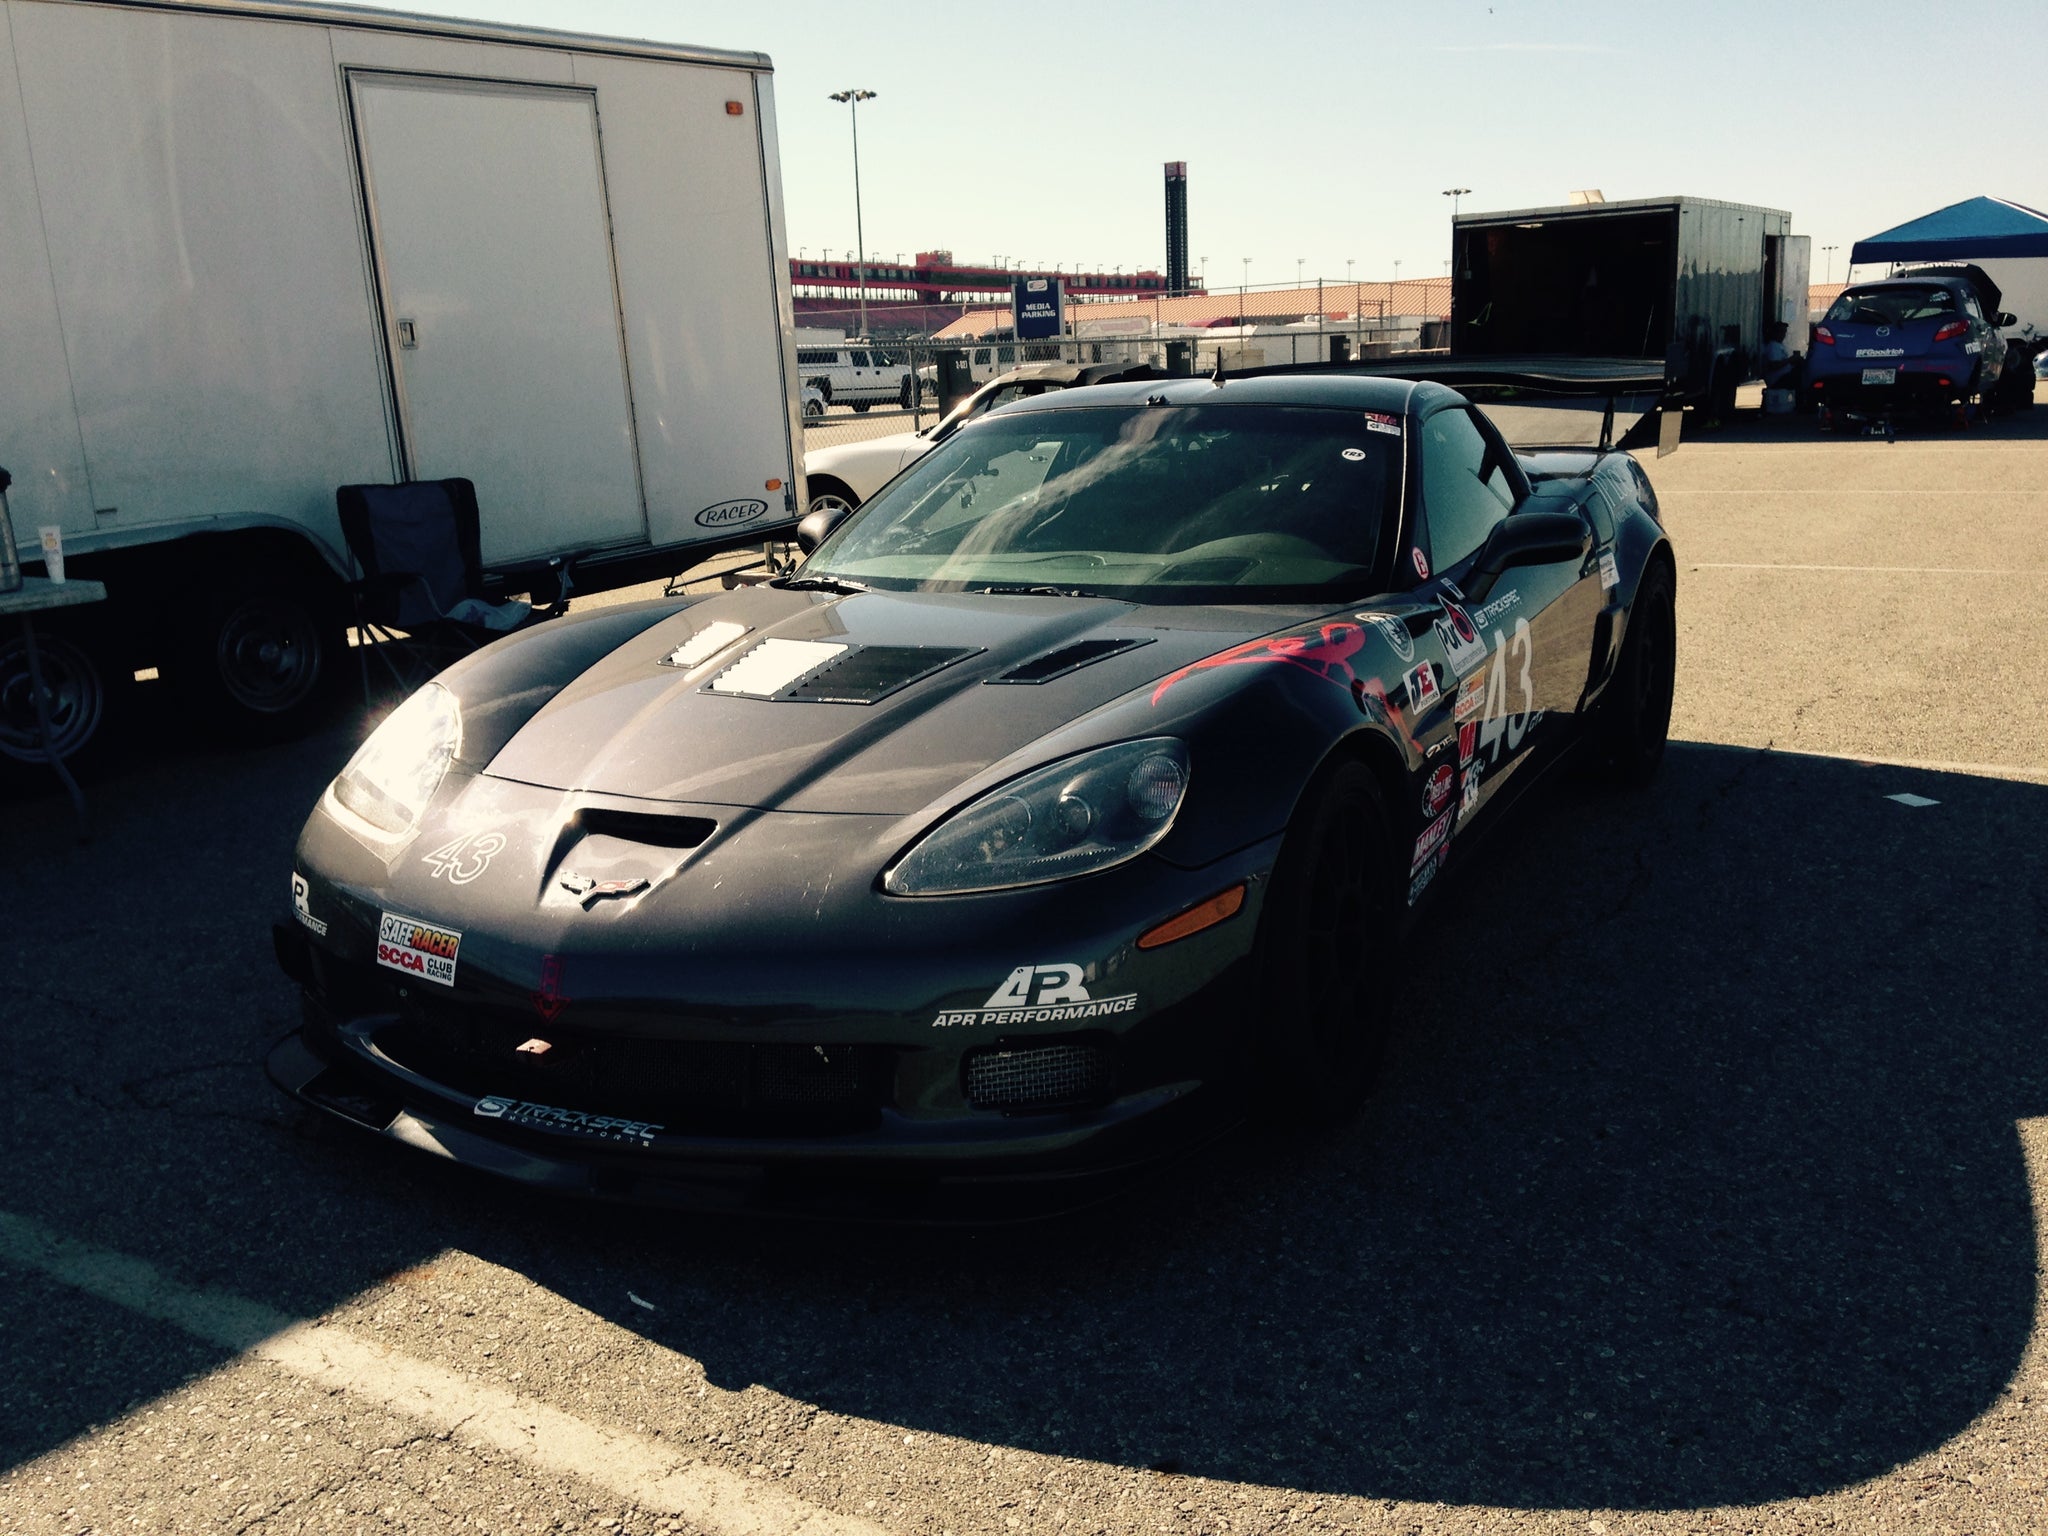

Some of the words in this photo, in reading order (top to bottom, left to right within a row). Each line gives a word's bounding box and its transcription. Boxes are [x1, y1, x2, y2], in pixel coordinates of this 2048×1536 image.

[1021, 309, 1056, 319] PARKING
[1025, 303, 1051, 311] MEDIA
[1343, 450, 1364, 458] TRS
[705, 503, 760, 524] RACER
[1479, 617, 1534, 764] 43
[421, 829, 507, 885] 43
[378, 944, 425, 973] SCCA
[427, 958, 453, 974] CLUB
[426, 967, 452, 982] RACING
[931, 1013, 977, 1028] APR
[980, 996, 1138, 1026] PERFORMANCE
[507, 1115, 650, 1147] MOTORSPORTS
[513, 1101, 665, 1139] TRACKSPEC
